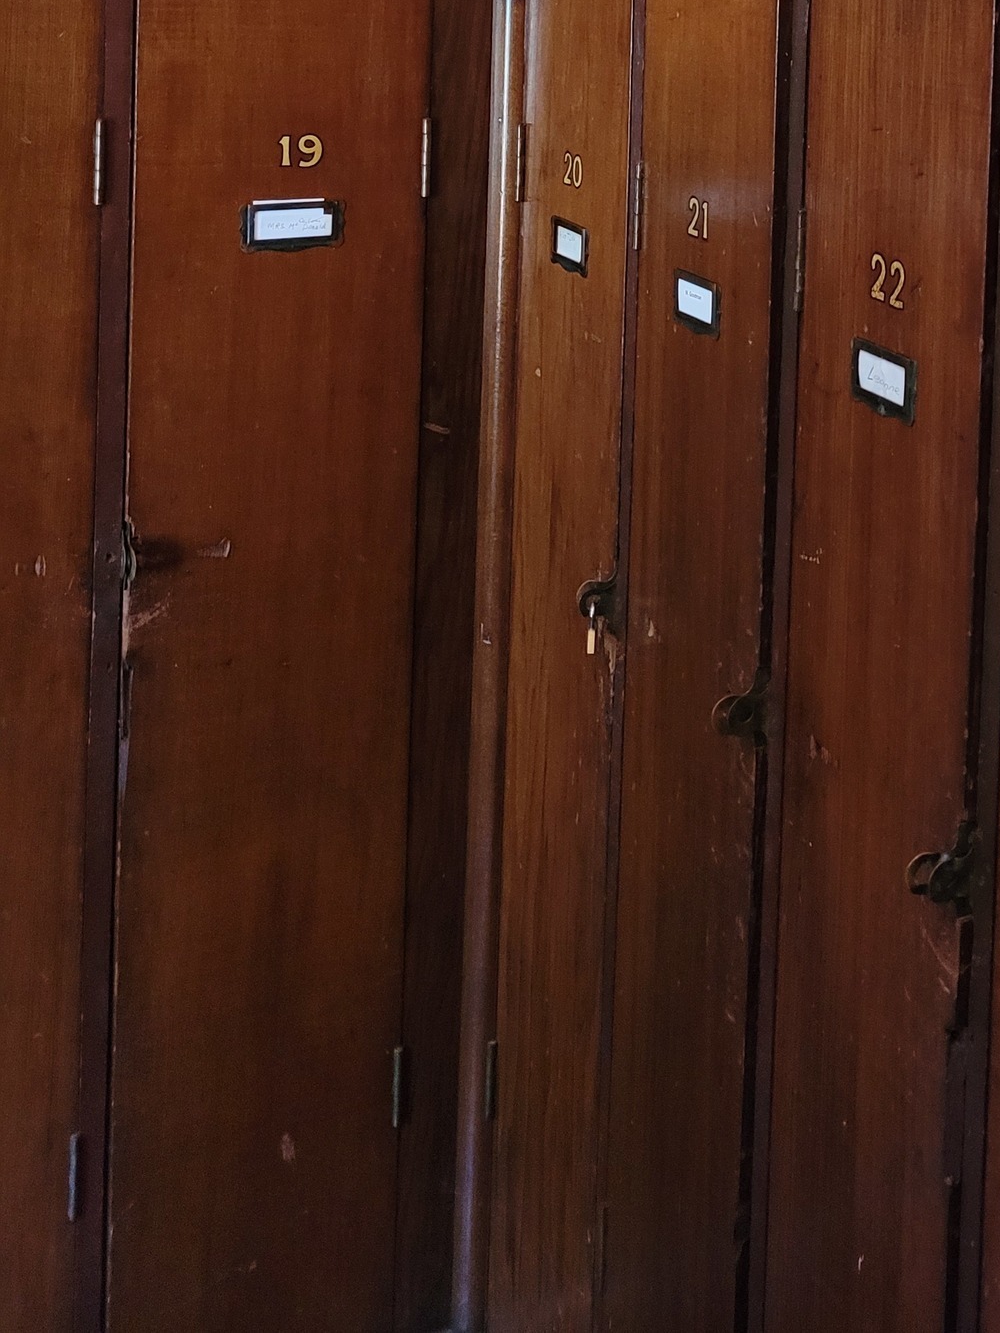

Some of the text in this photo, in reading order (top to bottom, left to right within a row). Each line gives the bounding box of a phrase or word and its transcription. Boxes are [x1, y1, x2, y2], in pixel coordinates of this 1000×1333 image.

[278, 134, 323, 168] 19
[563, 152, 582, 187] 20
[687, 197, 708, 239] 21
[870, 253, 905, 309] 22
